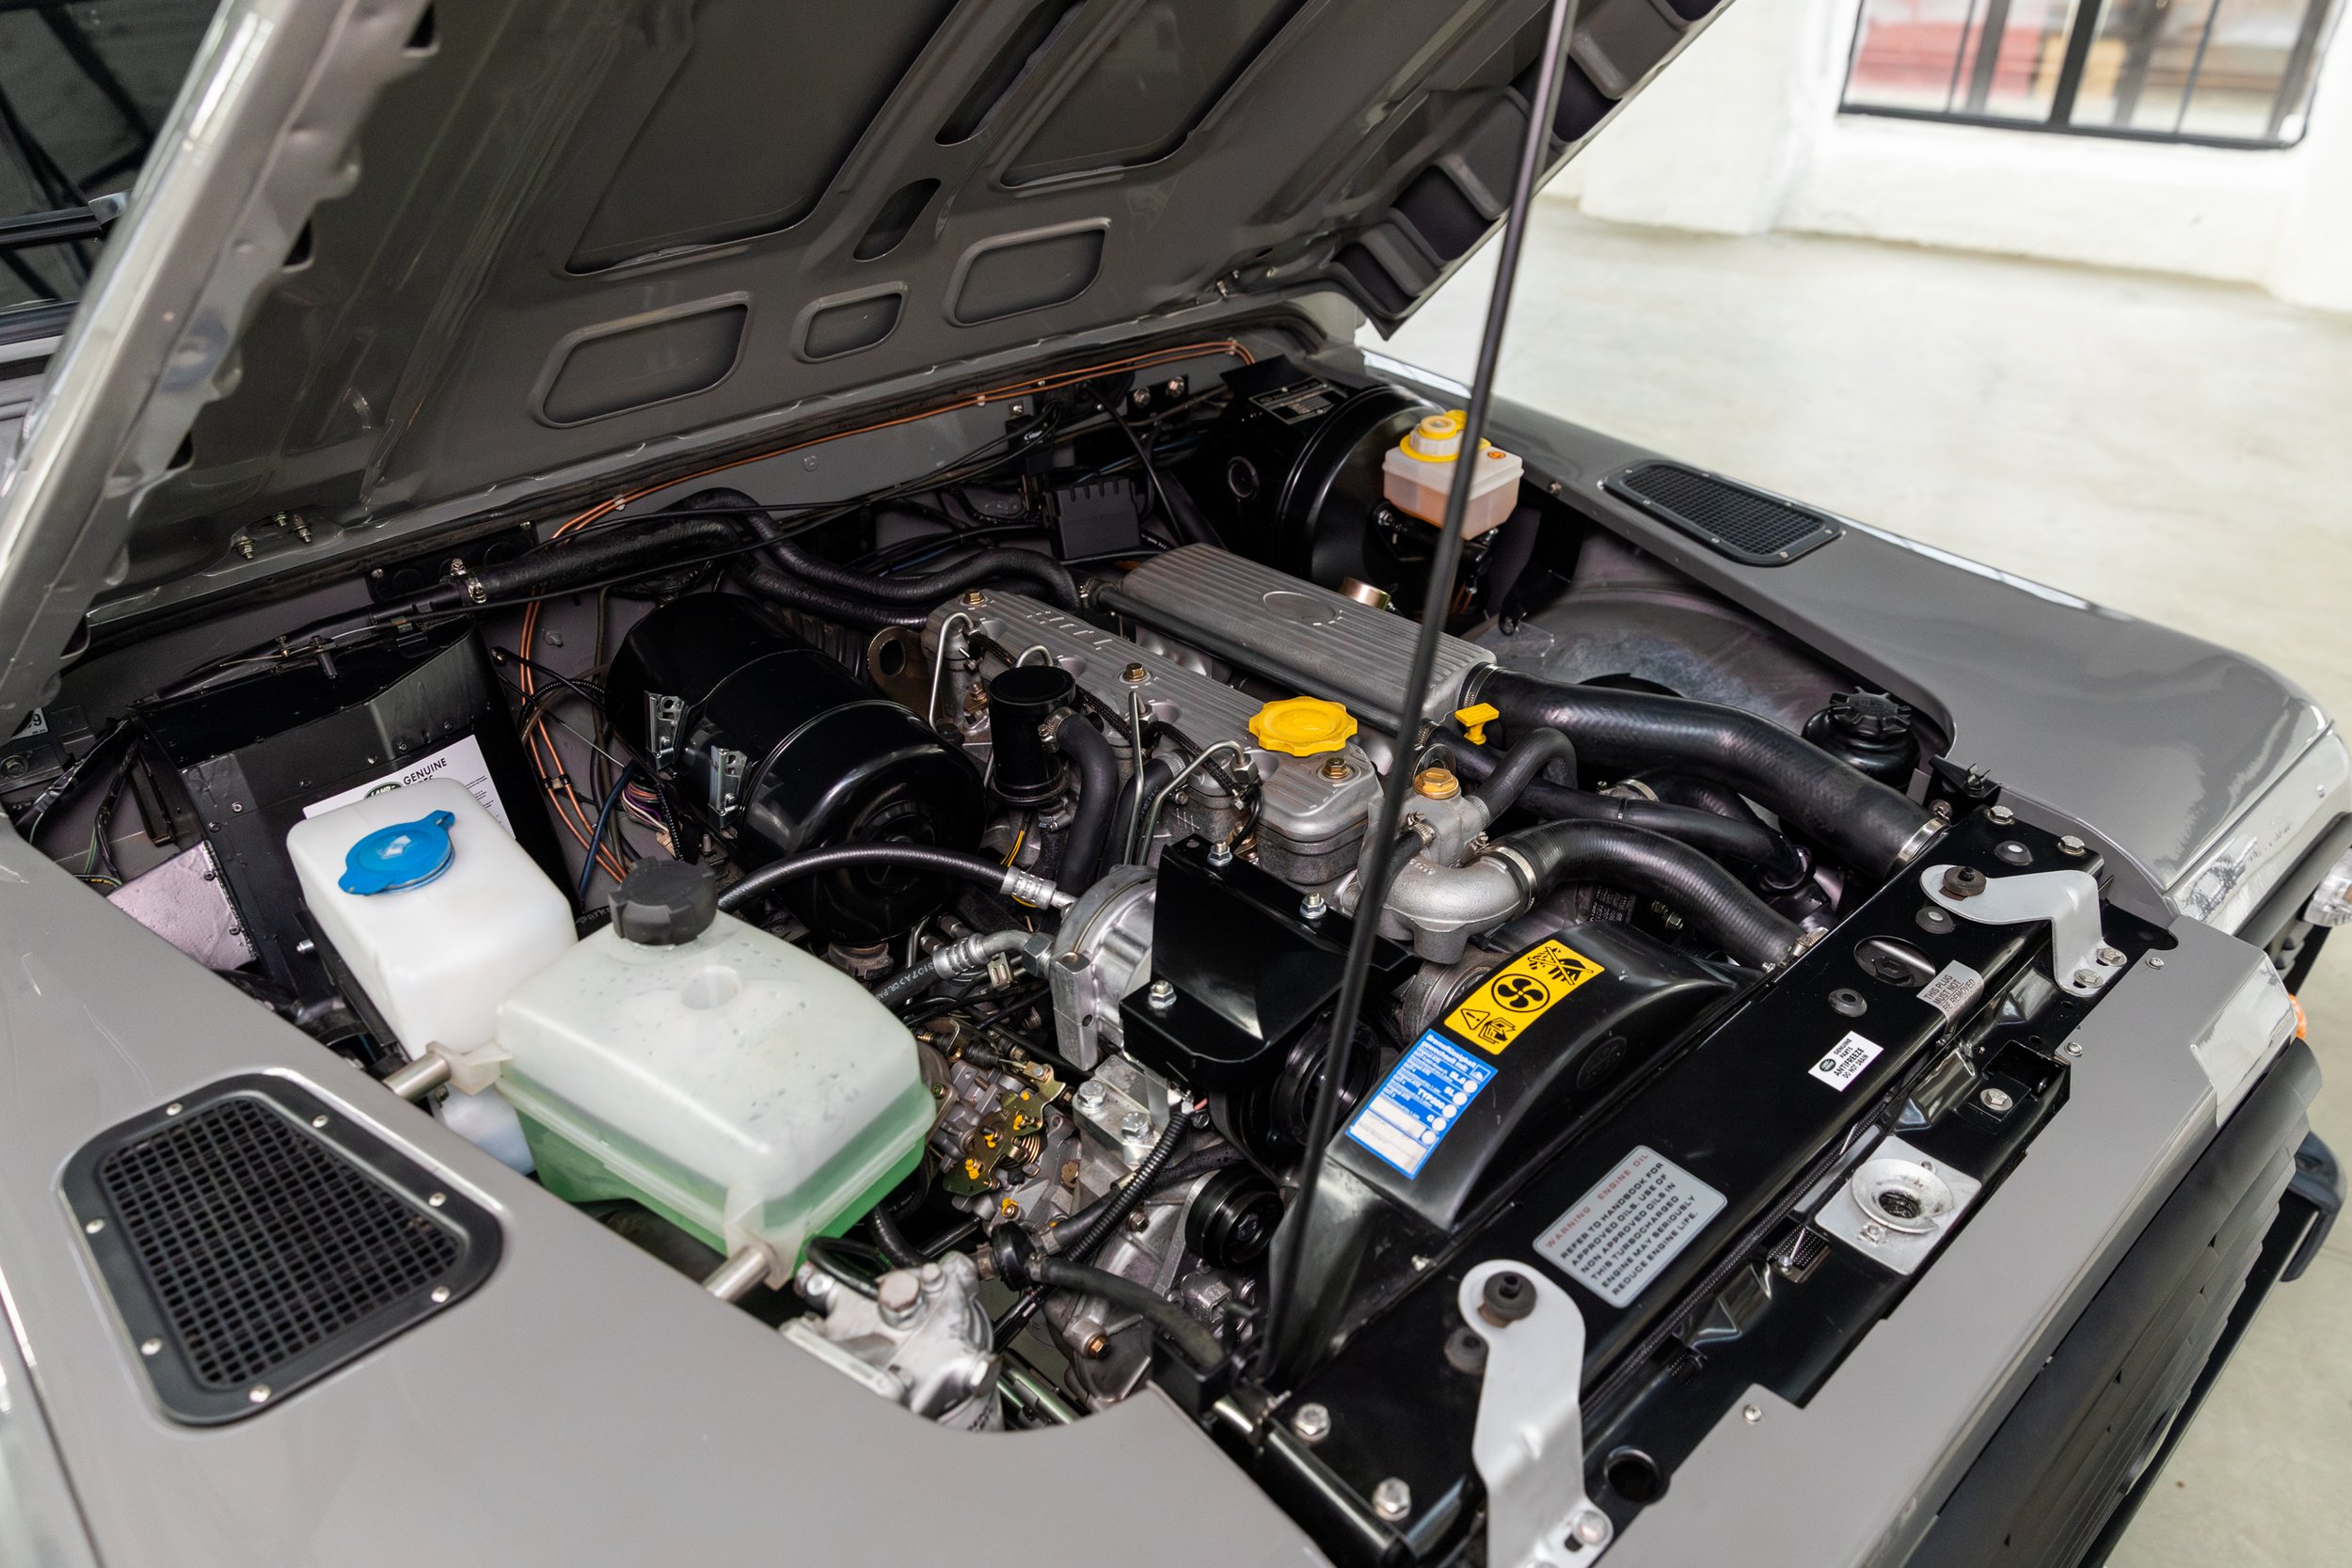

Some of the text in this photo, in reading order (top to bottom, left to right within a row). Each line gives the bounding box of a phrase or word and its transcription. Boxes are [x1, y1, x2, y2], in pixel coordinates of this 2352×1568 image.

[403, 758, 447, 785] GENUINE
[1924, 974, 1953, 1000] THIS PLUG
[1932, 979, 1962, 1005] MUST NOT
[1942, 978, 1976, 1012] BE REMOVED
[1833, 1037, 1852, 1055] GENUINE
[1833, 1047, 1865, 1077] ANTIFREEZE
[1839, 1046, 1853, 1059] PARTS
[1849, 1063, 1858, 1072] NOT
[1855, 1054, 1869, 1066] DRAIN
[1418, 1087, 1446, 1109] TYP200
[1545, 1153, 1649, 1249] WARNING ENGINE OIL
[1560, 1162, 1664, 1260] REFER TO HANDBOOK FOR
[1571, 1222, 1618, 1267] APPROVED
[1638, 1184, 1657, 1202] USE
[1655, 1173, 1669, 1186] OF
[1581, 1182, 1676, 1274] NON APPROVED OILS IN
[1590, 1195, 1679, 1281] THIS TURBOCHARGED
[1601, 1194, 1696, 1289] ENGINE MAY SERIOUSLY
[1612, 1211, 1699, 1296] REDUCE ENGINE LIFE.
